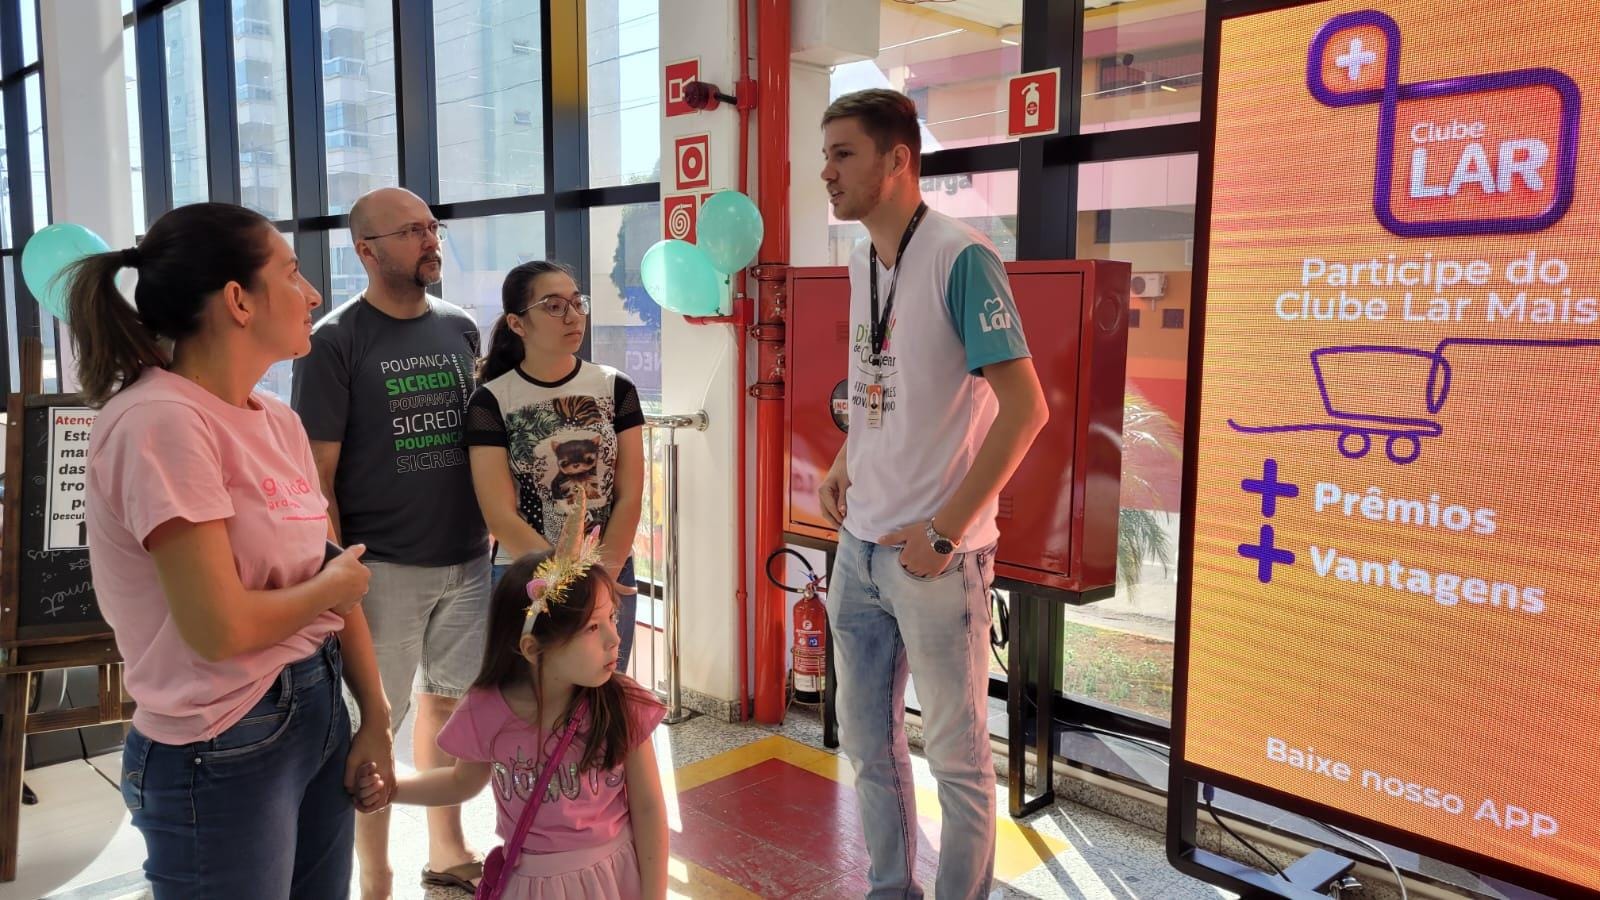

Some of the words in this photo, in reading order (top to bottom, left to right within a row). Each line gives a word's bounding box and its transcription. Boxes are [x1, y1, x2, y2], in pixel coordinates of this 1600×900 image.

[1410, 120, 1486, 144] Clube
[1408, 138, 1550, 199] LAR
[1301, 254, 1492, 292] Participe
[1506, 251, 1569, 285] do
[1275, 290, 1389, 321] Clube
[1403, 292, 1472, 321] Lar
[1486, 287, 1599, 325] Mais
[381, 353, 450, 374] POUPANÇA
[385, 371, 457, 396] SICREDI
[390, 391, 459, 412] POUPANÇA
[392, 409, 462, 436] SICREDI
[1314, 482, 1498, 535] Prêmios
[1309, 545, 1547, 614] Vantagens
[1266, 736, 1352, 782] Baixe
[1361, 769, 1464, 815] nosso
[1473, 799, 1560, 839] APP
